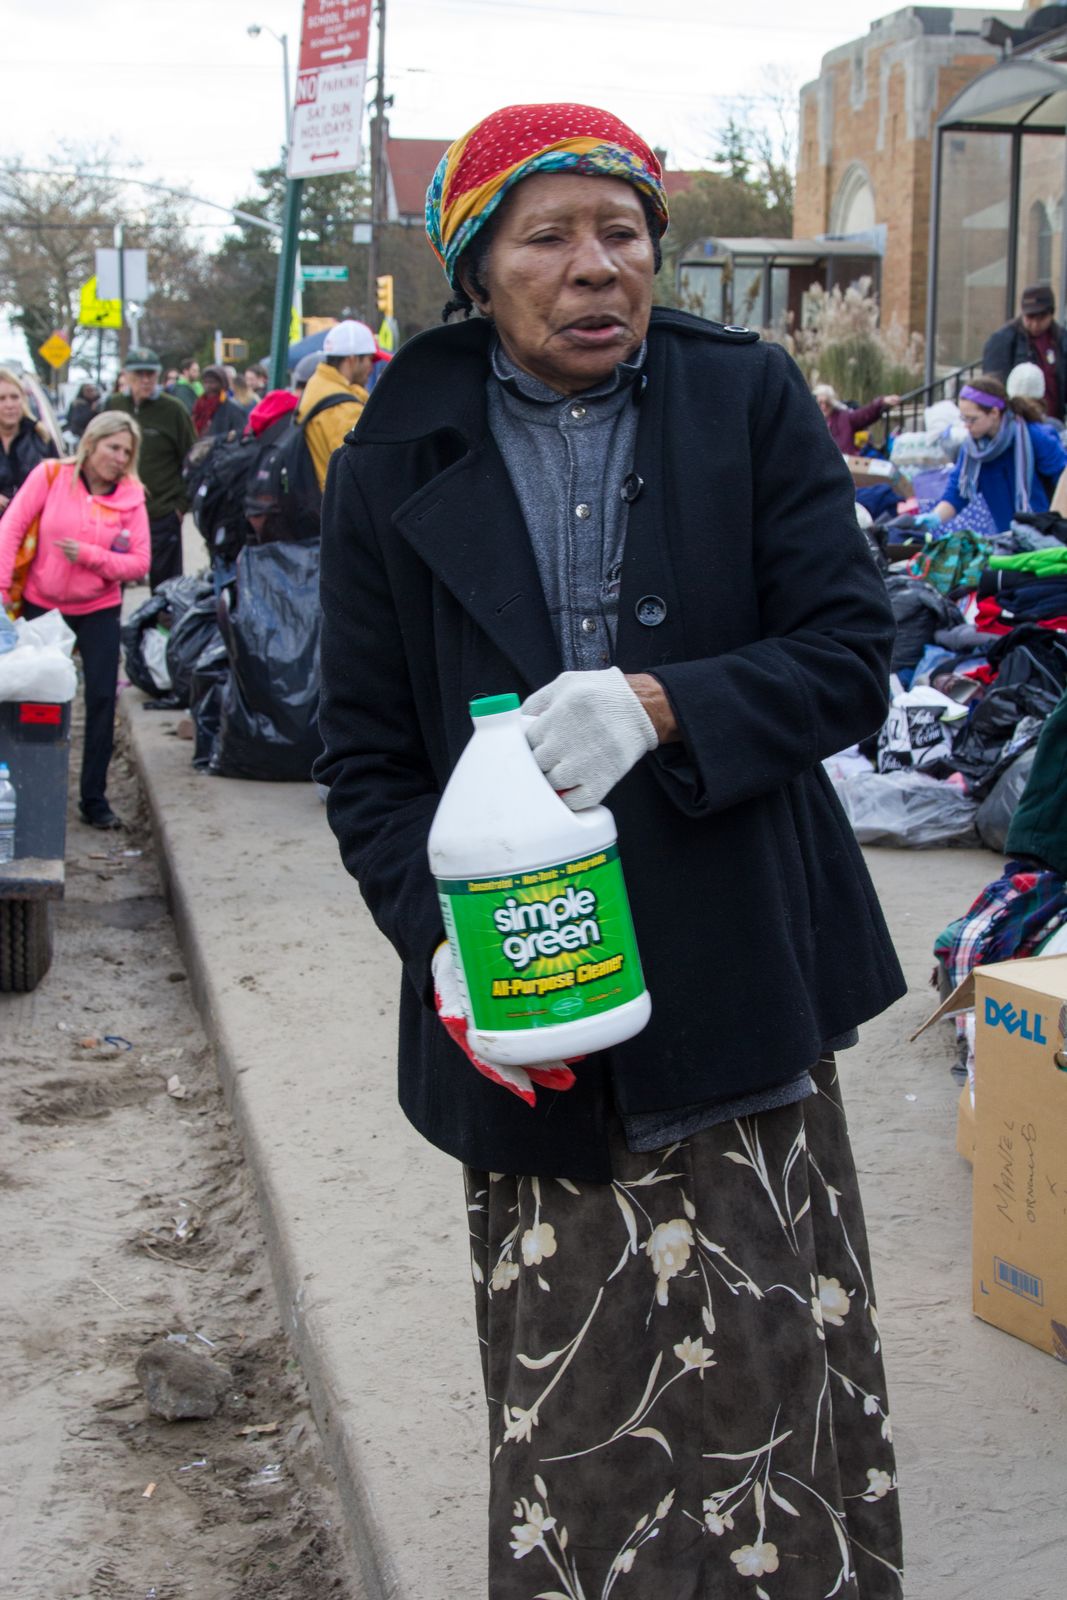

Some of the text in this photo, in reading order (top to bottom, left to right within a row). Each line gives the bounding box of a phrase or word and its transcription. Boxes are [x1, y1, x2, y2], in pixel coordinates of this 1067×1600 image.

[308, 12, 340, 29] SCHOOL
[343, 4, 367, 21] DAYS
[296, 74, 360, 102] NO PARKING
[301, 119, 353, 138] HOLIDAYS
[307, 102, 350, 120] SAT SUN
[493, 886, 596, 933] simple
[502, 918, 601, 969] green
[492, 970, 576, 997] All-Purpose
[576, 954, 624, 984] Cleaner
[985, 996, 1047, 1045] DELL
